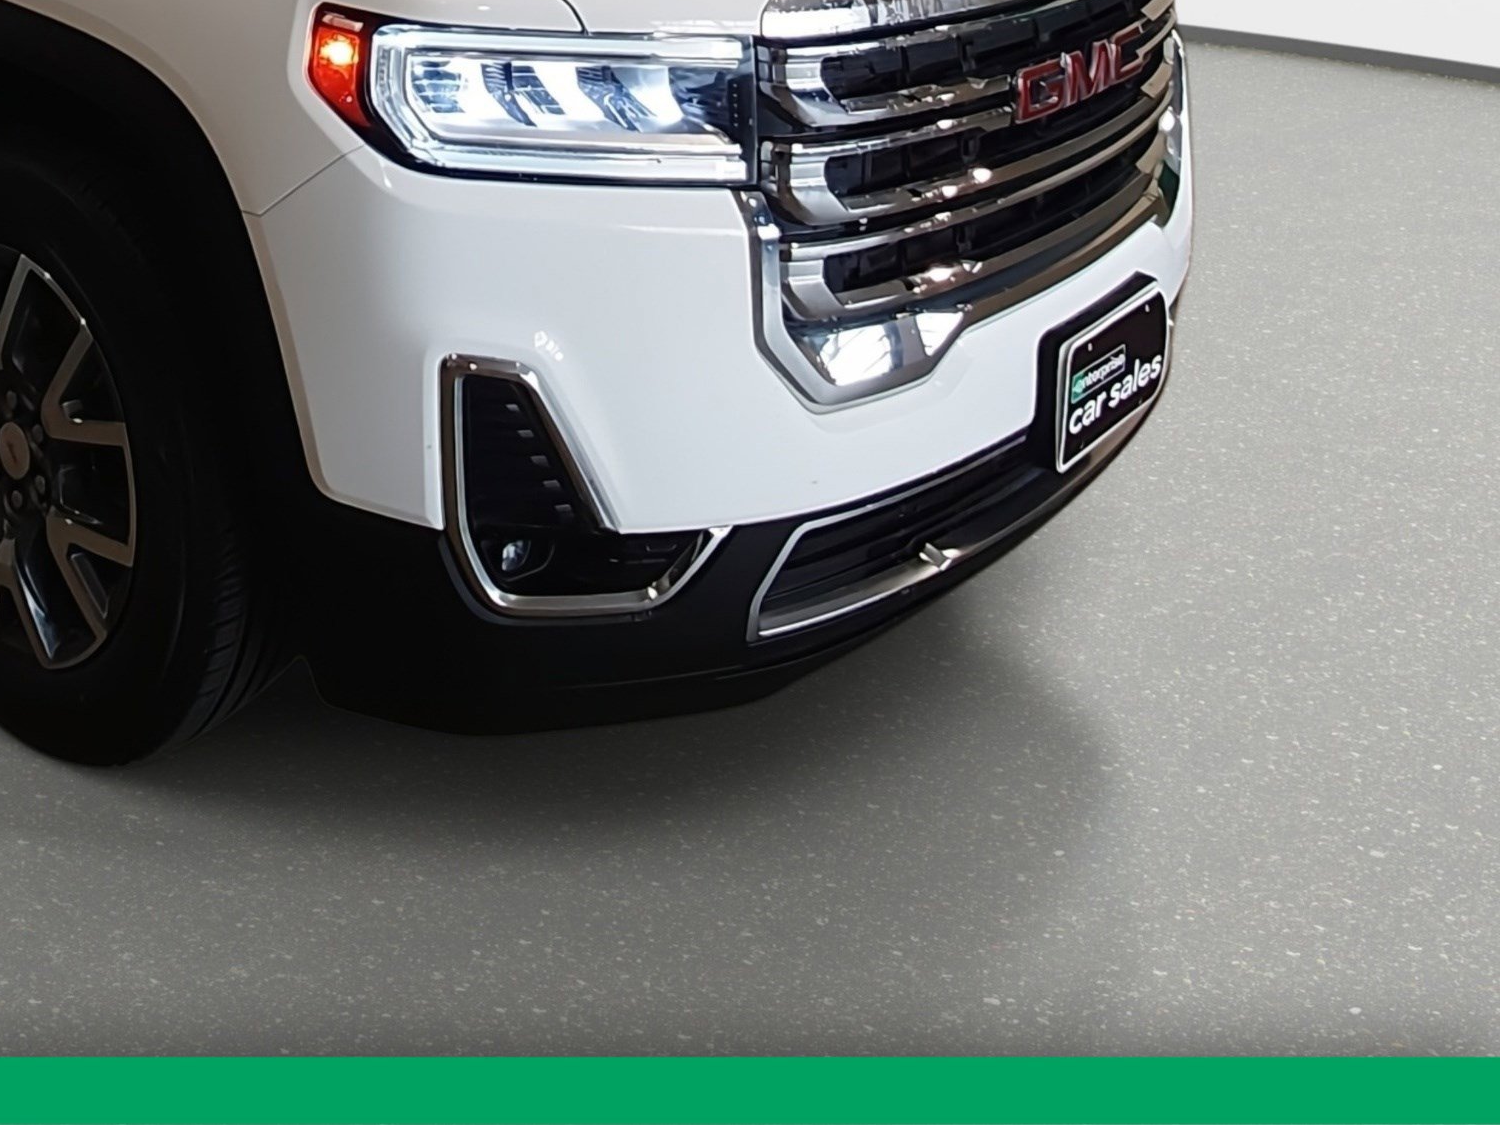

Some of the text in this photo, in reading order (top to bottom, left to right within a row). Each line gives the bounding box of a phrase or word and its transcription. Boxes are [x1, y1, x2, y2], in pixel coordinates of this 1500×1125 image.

[1014, 23, 1145, 124] GMC
[1069, 355, 1162, 434] car sales
